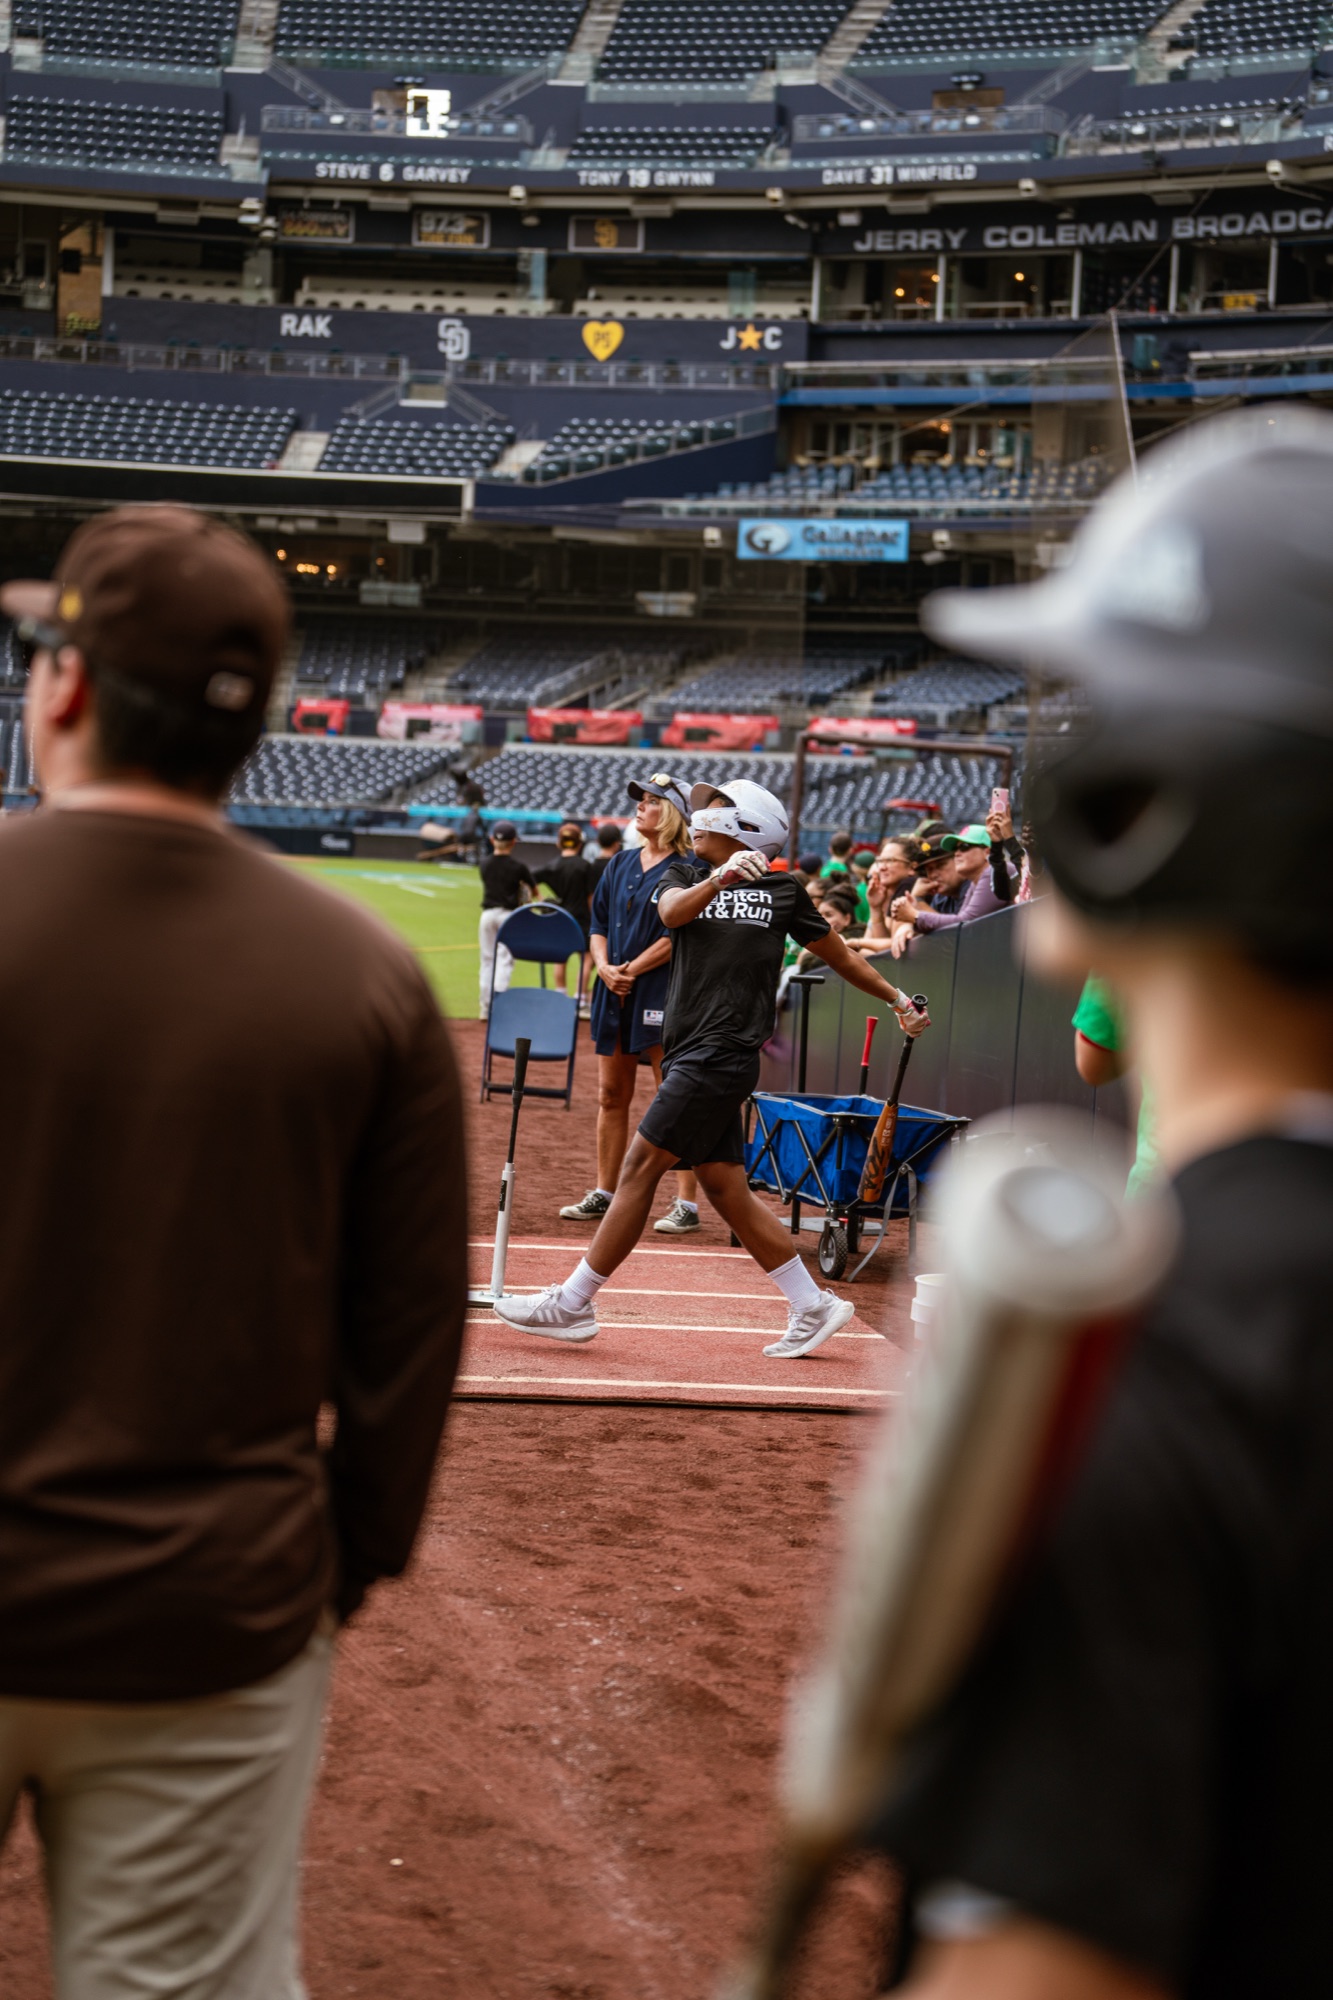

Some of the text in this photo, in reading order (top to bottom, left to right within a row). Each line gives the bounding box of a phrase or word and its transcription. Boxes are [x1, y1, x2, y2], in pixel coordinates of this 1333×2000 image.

[315, 162, 471, 183] STEVE 6 GARVEY
[578, 169, 714, 187] TONY 19 GWYNN
[822, 164, 977, 184] DAVE 31 WINFIELD
[853, 228, 967, 251] JERRY
[983, 219, 1158, 248] COLEMAN
[280, 313, 332, 338] RAK
[802, 524, 900, 546] Gallagher
[719, 890, 772, 904] Pitch
[714, 902, 730, 919] &
[731, 902, 773, 922] Run
